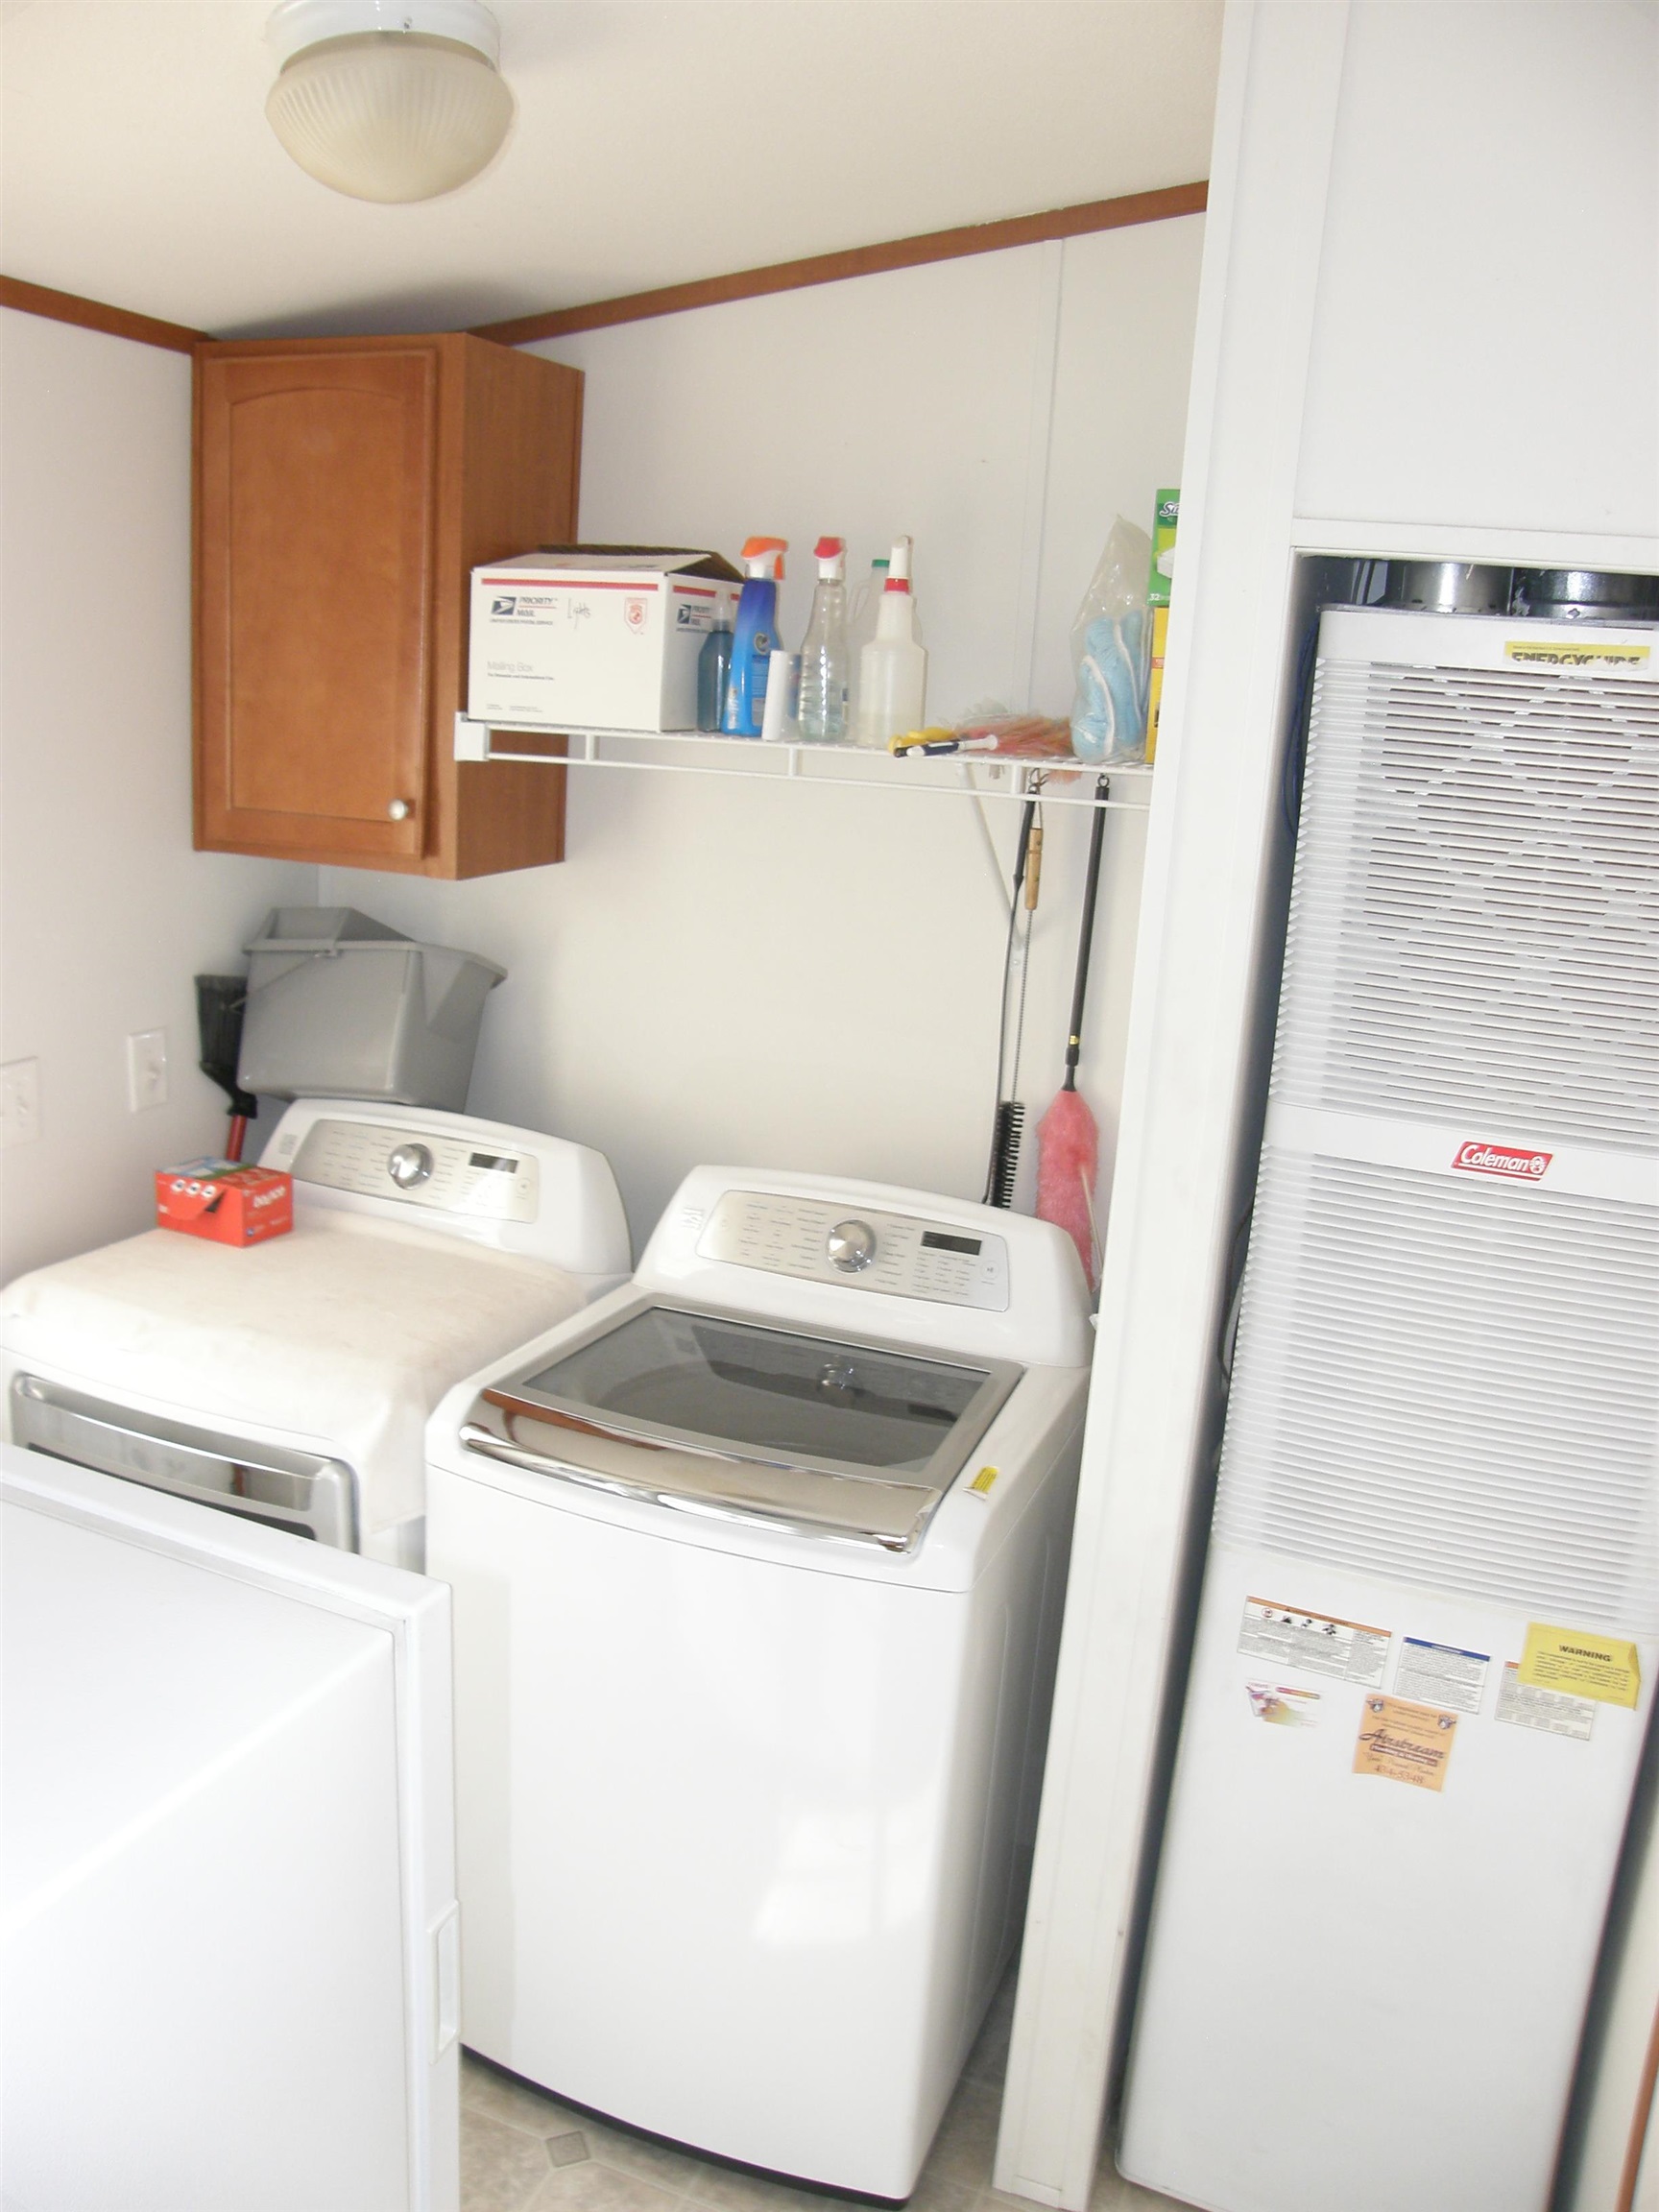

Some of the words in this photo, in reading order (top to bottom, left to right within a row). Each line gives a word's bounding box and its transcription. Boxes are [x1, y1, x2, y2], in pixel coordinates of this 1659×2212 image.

[518, 596, 554, 605] PRIORITY
[517, 661, 533, 672] Box
[1460, 1143, 1529, 1172] Coleman
[1558, 1644, 1613, 1663] WARNING
